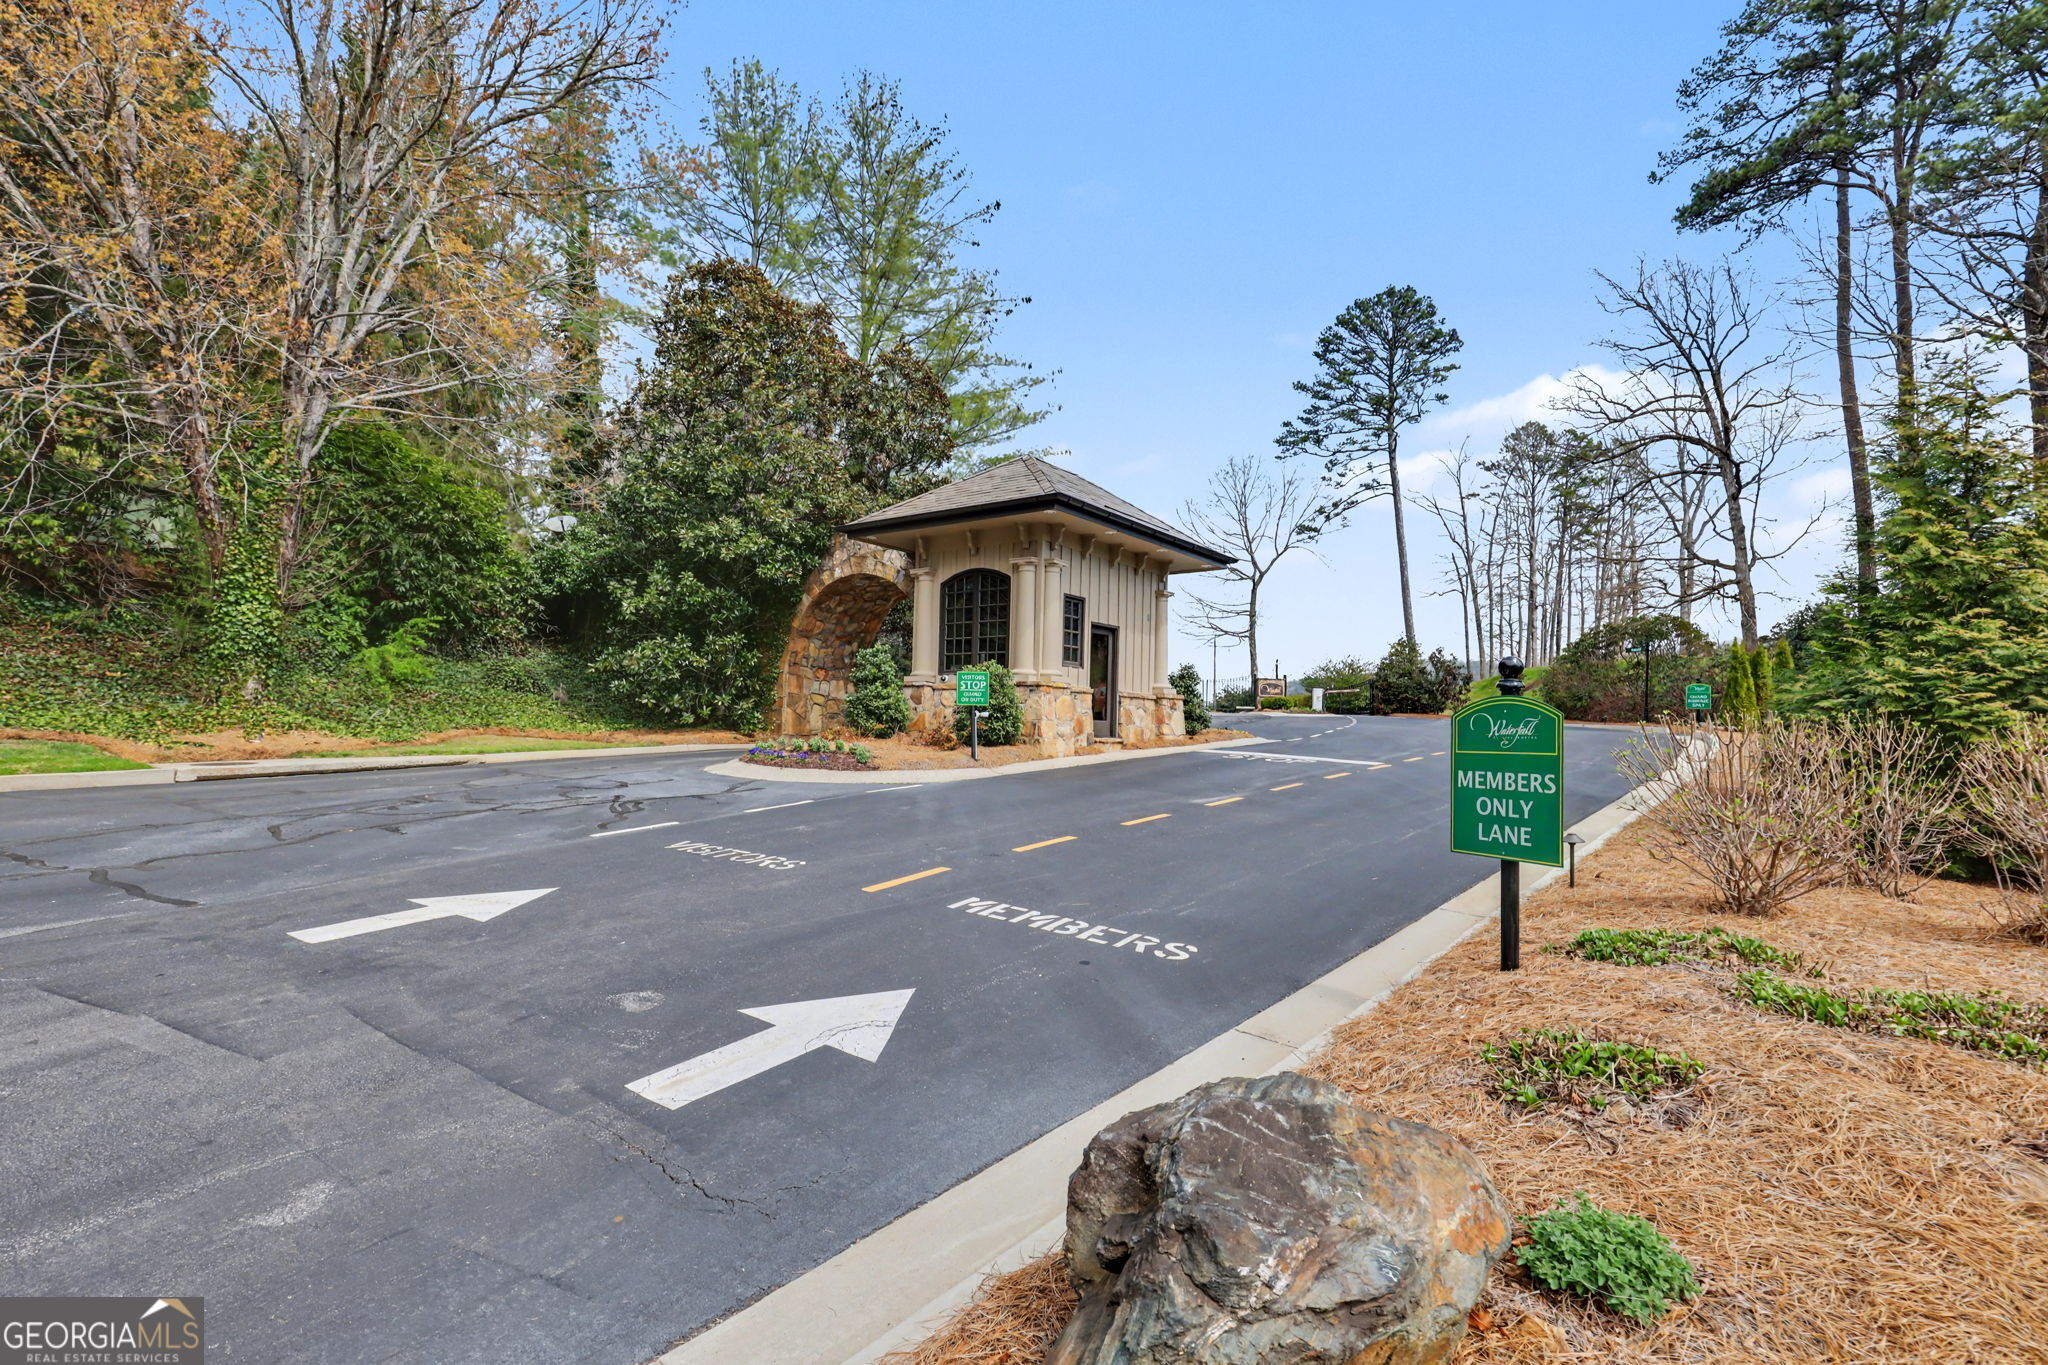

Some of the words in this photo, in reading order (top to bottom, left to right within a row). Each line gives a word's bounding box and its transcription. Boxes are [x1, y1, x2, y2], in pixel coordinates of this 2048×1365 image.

[960, 681, 986, 690] STOP
[1470, 712, 1542, 748] Waterfall
[1457, 769, 1557, 795] MEMBERS
[1476, 796, 1534, 820] ONLY
[1477, 822, 1532, 848] LANE
[664, 839, 806, 870] VISITORS
[946, 895, 1199, 961] MEMBERS
